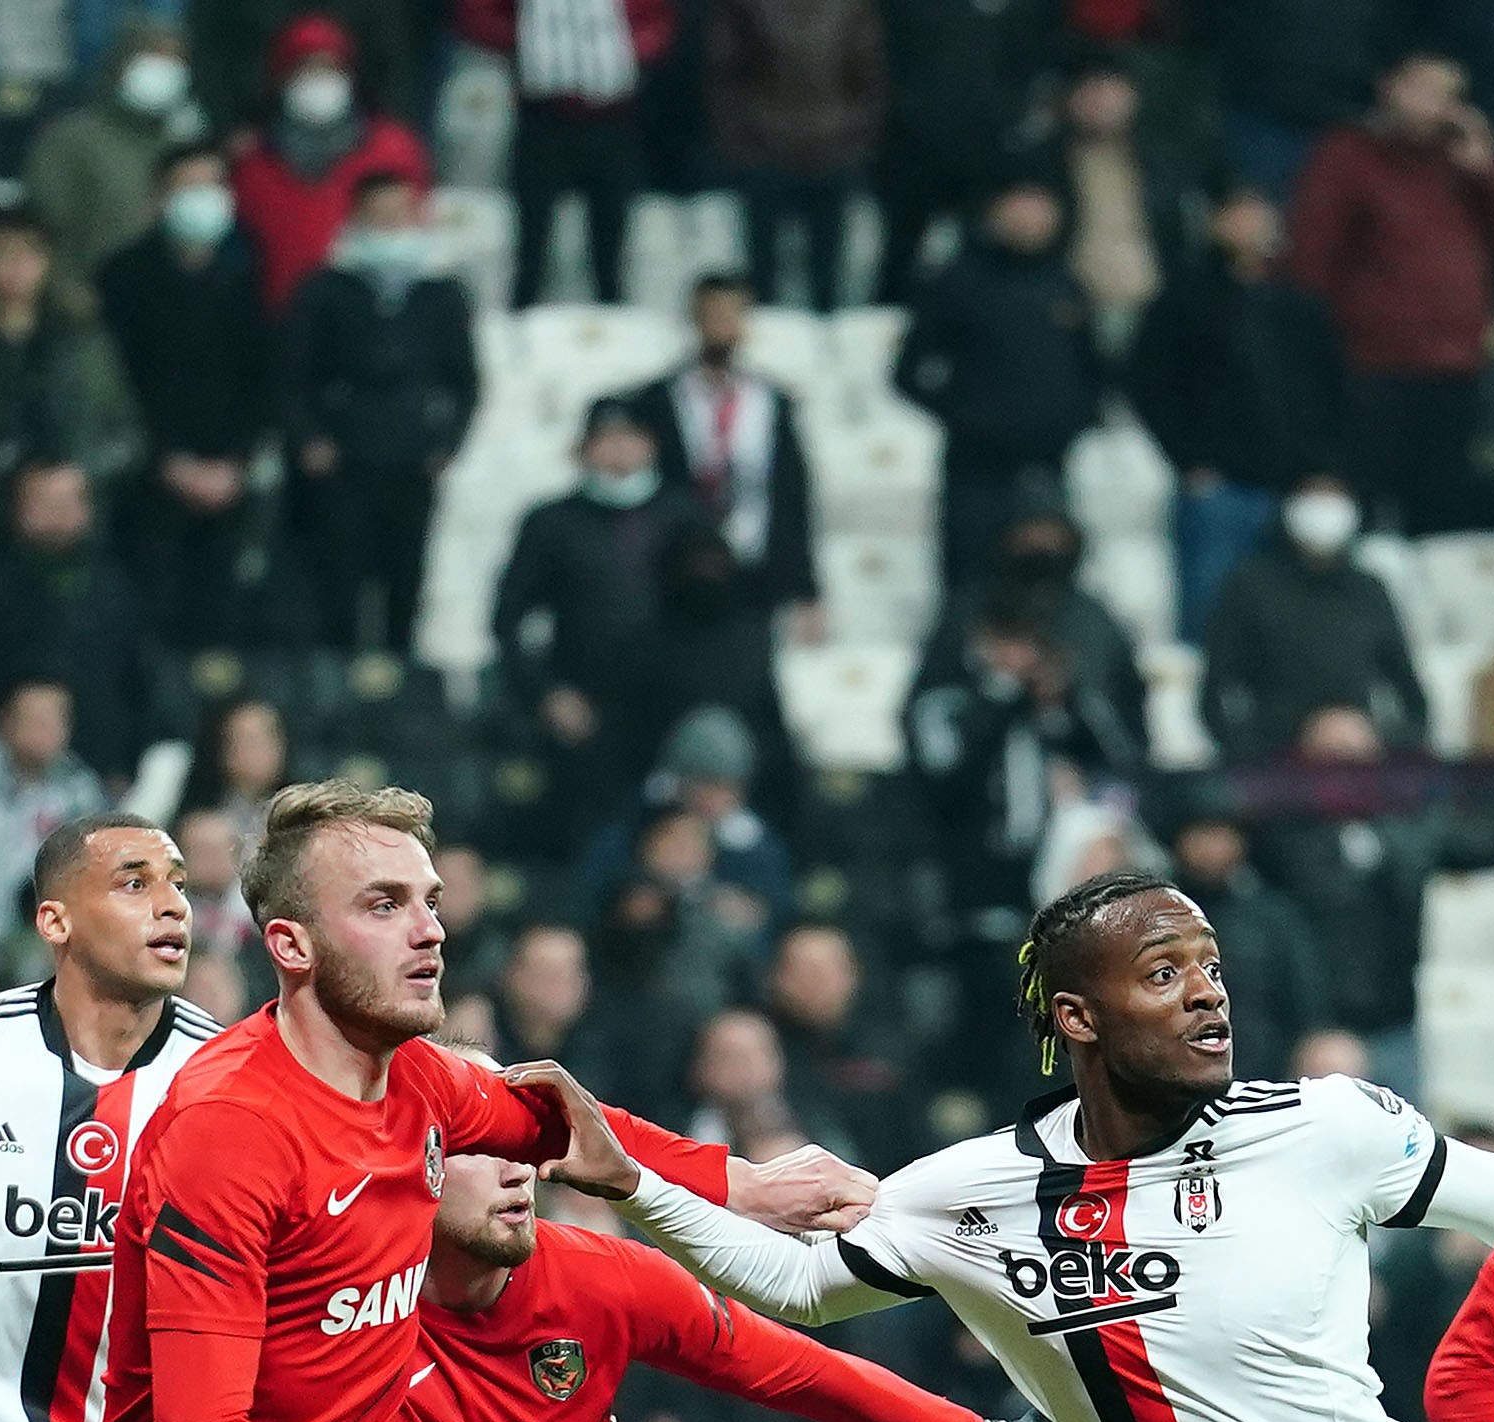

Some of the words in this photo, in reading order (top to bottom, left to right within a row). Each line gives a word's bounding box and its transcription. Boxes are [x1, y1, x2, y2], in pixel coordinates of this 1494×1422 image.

[5, 1184, 120, 1247] bek
[955, 1222, 999, 1238] adidas
[999, 1239, 1180, 1299] beko
